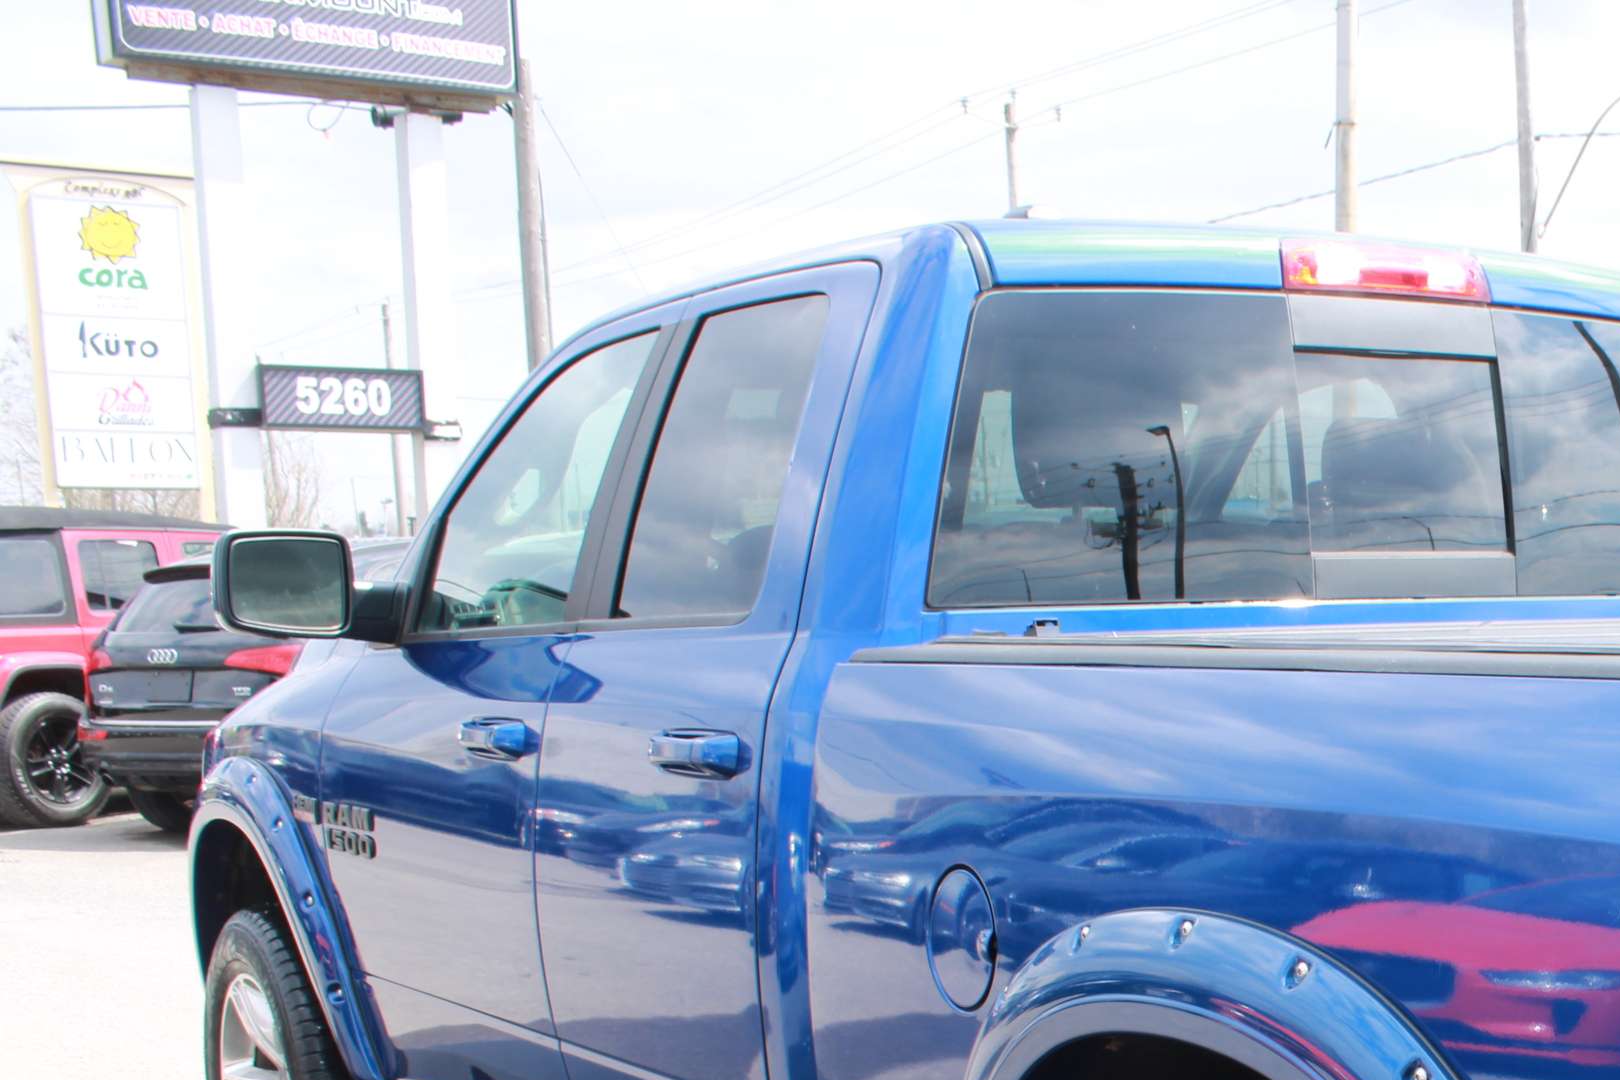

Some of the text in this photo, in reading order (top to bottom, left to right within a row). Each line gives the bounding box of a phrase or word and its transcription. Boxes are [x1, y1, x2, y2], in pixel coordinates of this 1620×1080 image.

[127, 5, 505, 66] VENTE ACHAT ÉCHANGE FINANCEMENT
[78, 267, 148, 290] cora
[295, 376, 392, 417] 5260
[321, 800, 374, 832] RAM
[322, 824, 377, 859] 1500
